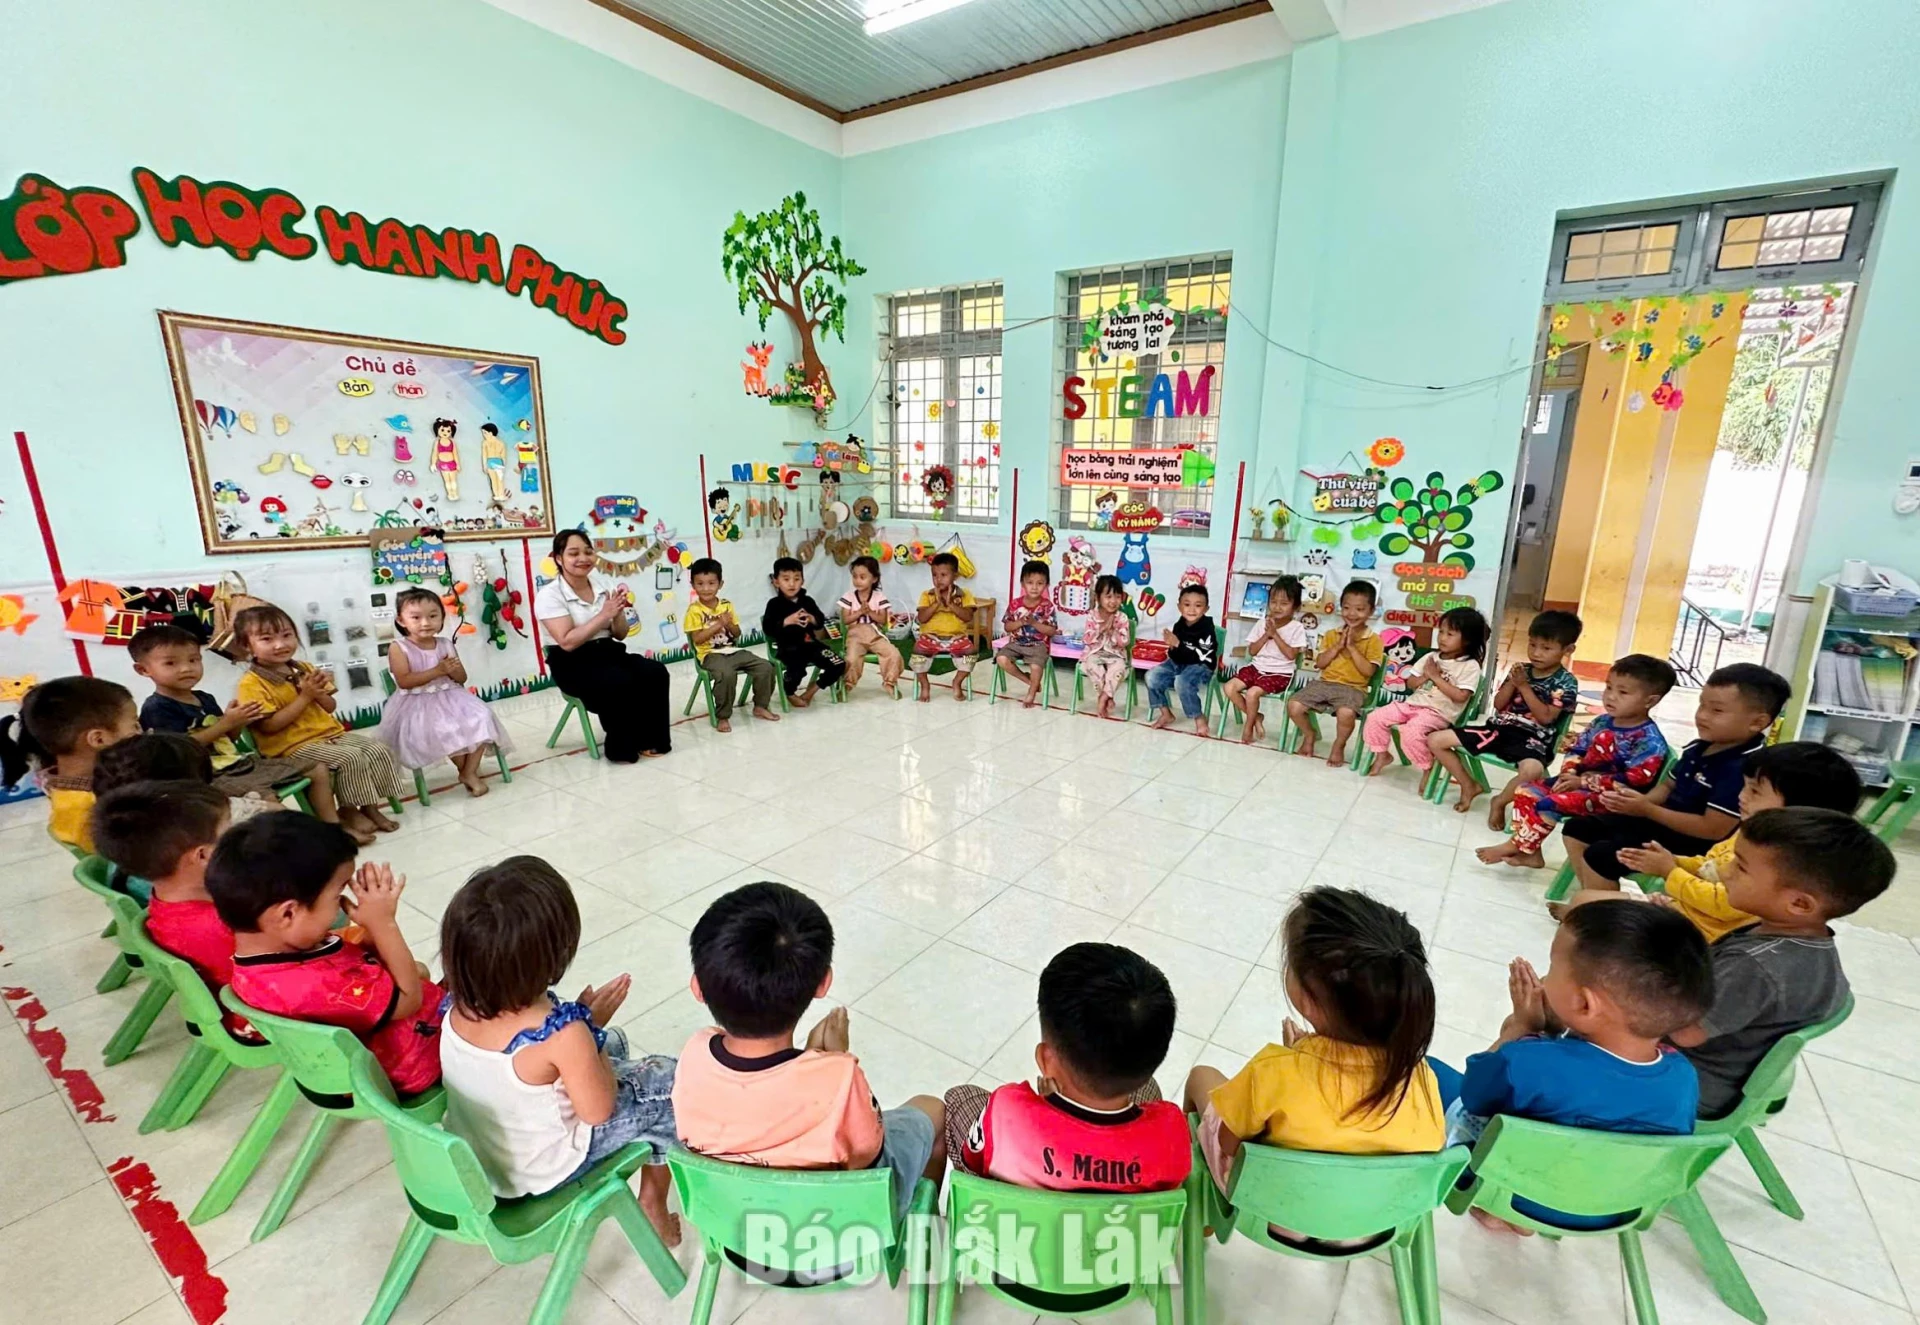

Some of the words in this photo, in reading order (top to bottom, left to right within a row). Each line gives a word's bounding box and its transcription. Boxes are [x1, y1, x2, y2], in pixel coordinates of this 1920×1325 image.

[133, 168, 316, 260] HỌC
[316, 206, 503, 284] HẠNH
[506, 244, 628, 345] PHÚC
[1142, 309, 1164, 324] phá
[1110, 326, 1137, 339] sáng
[1144, 324, 1163, 336] tạo
[345, 355, 386, 374] Chủ
[392, 358, 417, 376] đề
[343, 380, 370, 392] Bản
[397, 384, 424, 395] thân
[1063, 369, 1212, 420] STEAM
[1067, 454, 1086, 466] học
[1138, 456, 1178, 470] nghiệm
[731, 461, 802, 491] MUSIC
[1069, 468, 1084, 479] lớn
[1086, 469, 1101, 479] lên
[1103, 469, 1130, 482] cùng
[1134, 471, 1160, 484] sáng
[1163, 472, 1182, 484] tạo
[1319, 477, 1347, 490] Thư
[1349, 478, 1377, 493] viện
[1123, 500, 1145, 514] GÓC
[1359, 494, 1377, 508] bé
[1395, 563, 1424, 577] đọc
[1427, 564, 1465, 578] sách
[1402, 578, 1427, 592] mở
[1433, 582, 1451, 593] ra
[1043, 1146, 1062, 1178] S.
[1072, 1155, 1142, 1184] Mané
